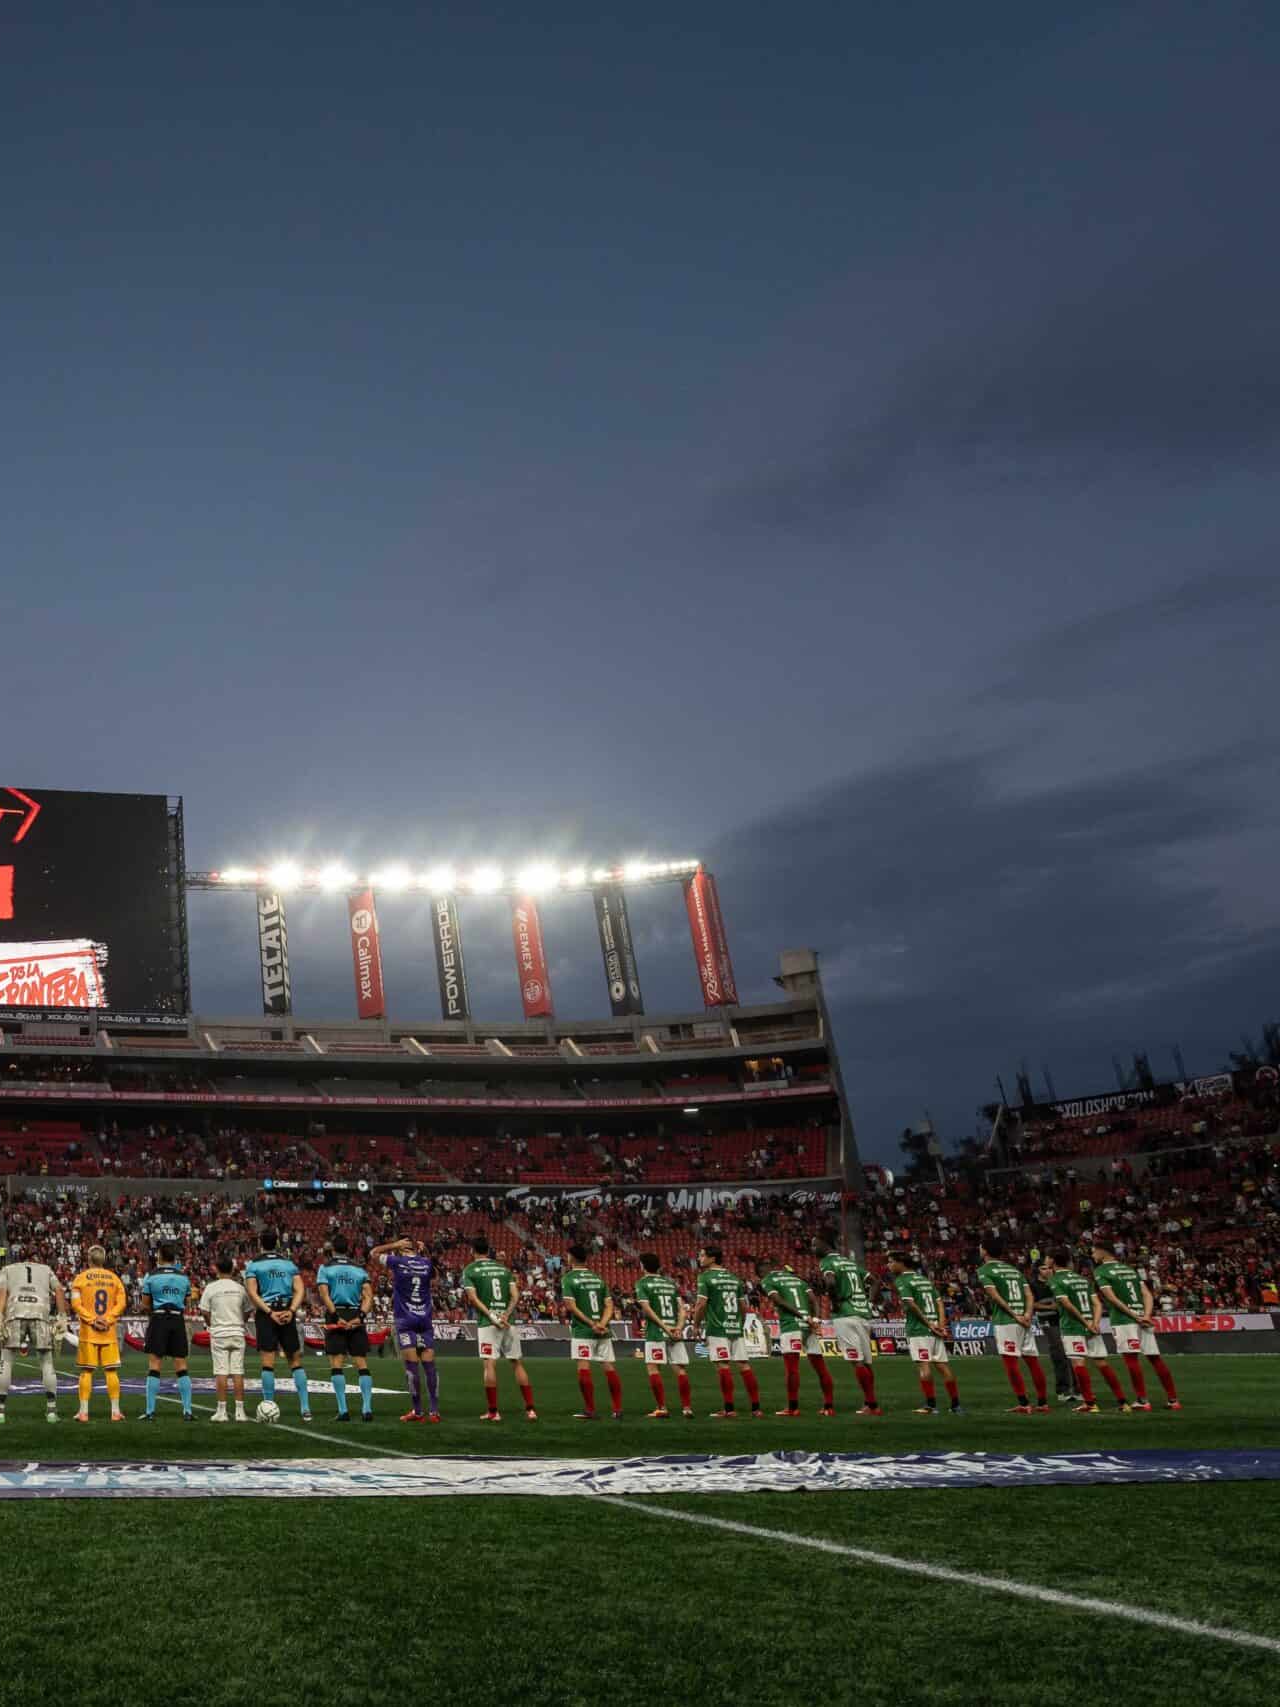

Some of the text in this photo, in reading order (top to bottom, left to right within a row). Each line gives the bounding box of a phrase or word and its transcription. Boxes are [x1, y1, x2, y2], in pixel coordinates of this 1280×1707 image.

[259, 895, 283, 1008] TECATE
[437, 898, 461, 1017] POWERADE
[519, 922, 533, 972] CEMEX
[358, 936, 373, 1001] Calimax
[26, 1266, 33, 1284] 1
[95, 1289, 108, 1315] 8
[491, 1278, 503, 1301] 6
[790, 1288, 801, 1308] 1
[955, 1323, 990, 1338] telcel
